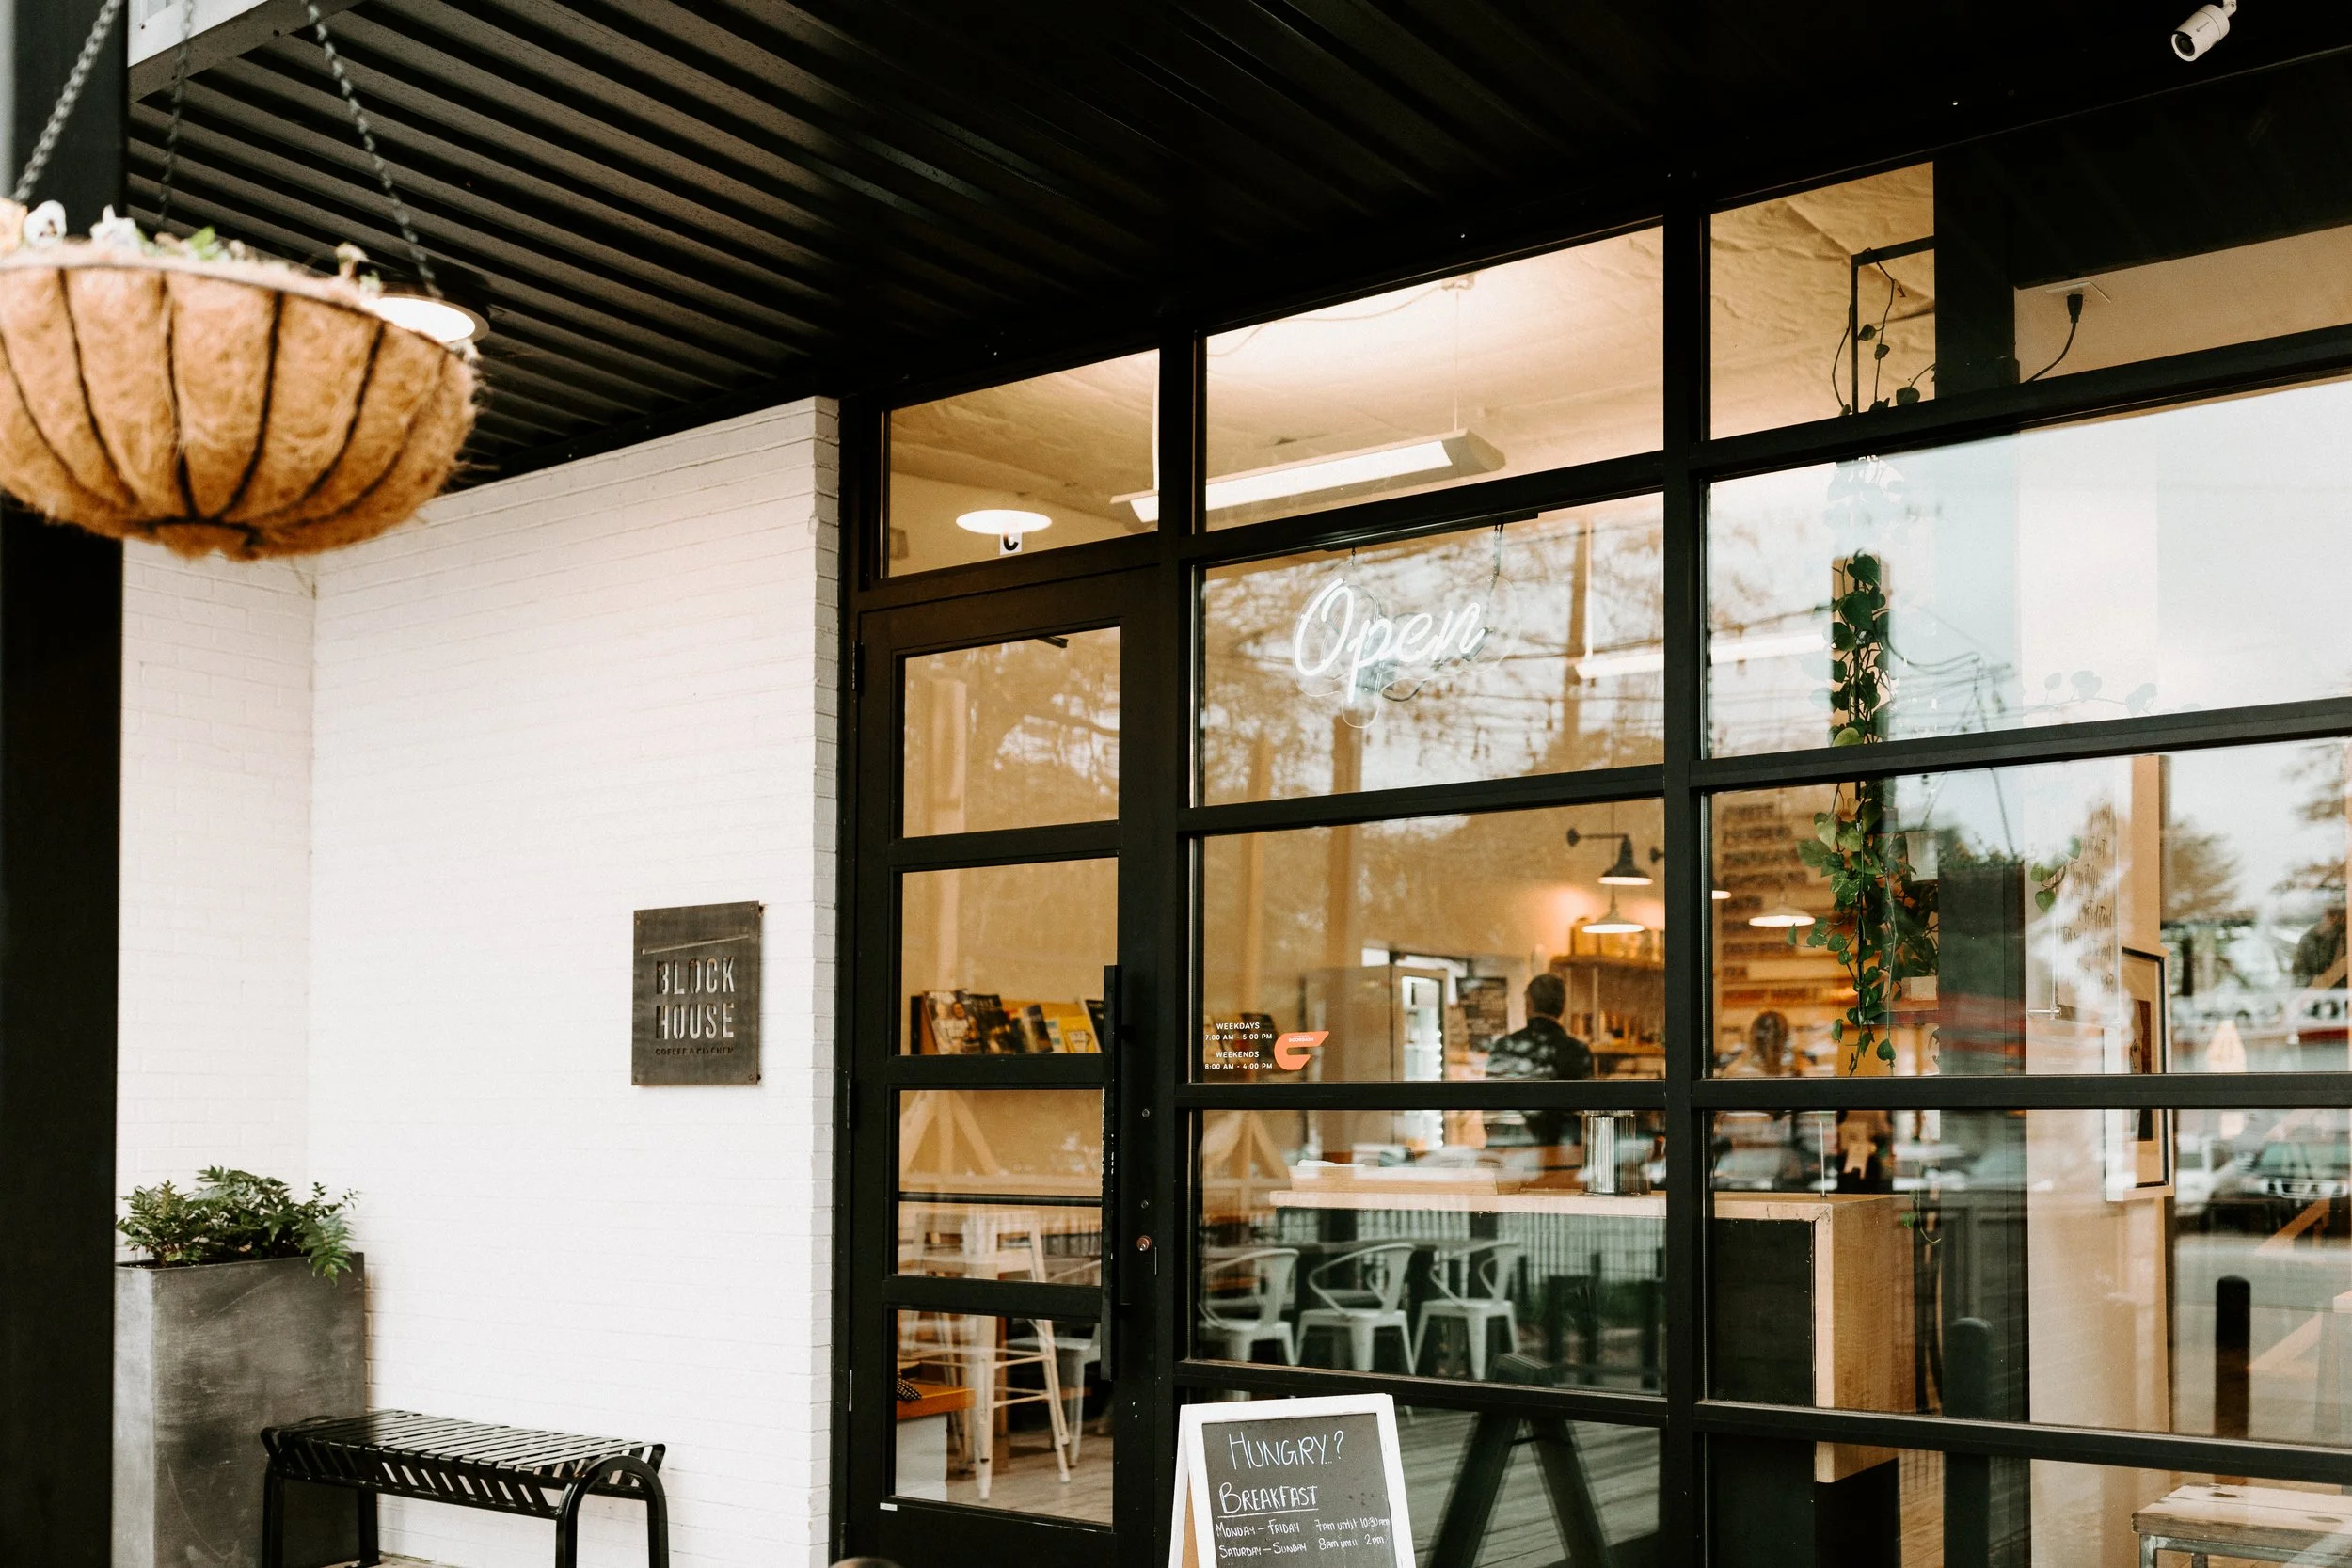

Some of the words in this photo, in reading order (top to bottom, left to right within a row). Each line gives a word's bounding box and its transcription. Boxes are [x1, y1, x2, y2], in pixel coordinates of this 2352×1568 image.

[1294, 578, 1486, 704] Open
[656, 956, 735, 995] BLOCK
[656, 1002, 735, 1040] HOUSE
[1218, 1481, 1318, 1513] BREAKFAST
[1216, 1522, 1256, 1538] MONDAY
[1268, 1518, 1300, 1535] FRIDAY
[1218, 1544, 1262, 1559] SATURDAY
[1272, 1541, 1307, 1554] SUNDAY
